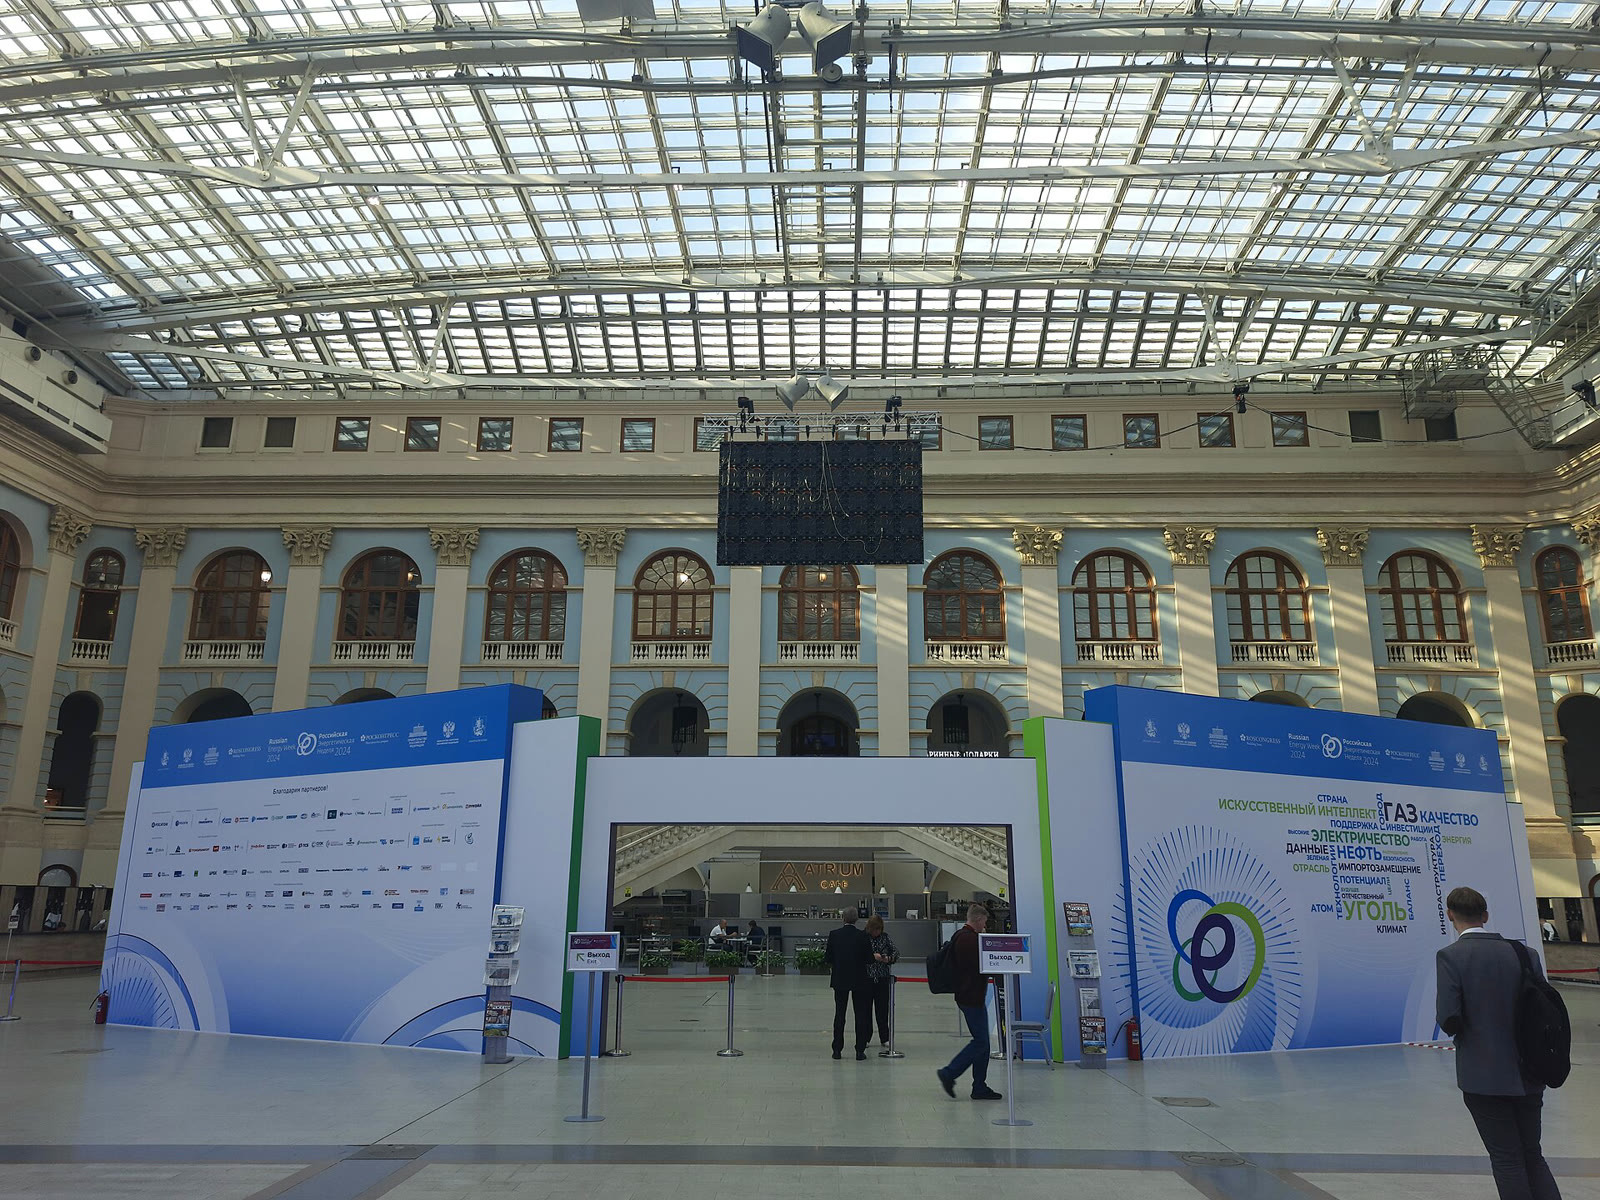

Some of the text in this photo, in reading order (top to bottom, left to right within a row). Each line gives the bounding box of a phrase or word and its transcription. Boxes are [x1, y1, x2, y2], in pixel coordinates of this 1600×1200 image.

[319, 731, 348, 740] Российская
[1246, 735, 1281, 744] ROSCONGRESS
[1288, 733, 1310, 741] Russian
[1288, 741, 1306, 750] Energy
[1342, 738, 1372, 747] Российская
[267, 745, 283, 754] Energy
[334, 746, 351, 757] 2024
[1290, 750, 1306, 759] 2024
[267, 754, 281, 763] 2024
[1363, 757, 1379, 767] 2024
[272, 787, 301, 795] Благодарим
[1317, 794, 1348, 804] СТРАНА
[1218, 798, 1377, 820] ИСКУССТВЕННЫЙ ИНТЕЛЛЕКТ
[1376, 792, 1386, 831] ГОРОД
[1383, 801, 1419, 824] ГАЗ
[1419, 810, 1479, 827] КАЧЕСТВО
[1330, 819, 1379, 831] ПОДДЕРЖКА
[1385, 823, 1434, 834] ИНВЕСТИЦИИ
[1311, 829, 1411, 847] ЭЛЕКТРИЧЕСТВО
[1442, 835, 1472, 845] ЭНЕРГИЯ
[1286, 843, 1329, 855] ДАННЫЕ
[1337, 845, 1383, 861] НЕФТЬ
[1433, 825, 1446, 882] ПЕРЕХОД
[804, 862, 865, 877] ATRIUM
[1293, 863, 1330, 873] ОТРАСЛЬ
[1338, 862, 1421, 874] ИМПОРТОЗАМЕЩЕНИЕ
[1329, 844, 1343, 920] ТЕХНОЛОГИИ
[1340, 875, 1387, 886] ПОТЕНЦИАЛ
[1429, 836, 1447, 935] ИНФРАСТРУКТУРА
[1341, 892, 1385, 900] ОТЕЧЕСТВЕННЫЙ
[1403, 878, 1415, 921] БАЛАНС
[1310, 903, 1334, 913] АТОМ
[1343, 900, 1407, 921] УГОЛЬ
[1376, 925, 1408, 934] КЛИМАТ
[989, 953, 1013, 961] Выход
